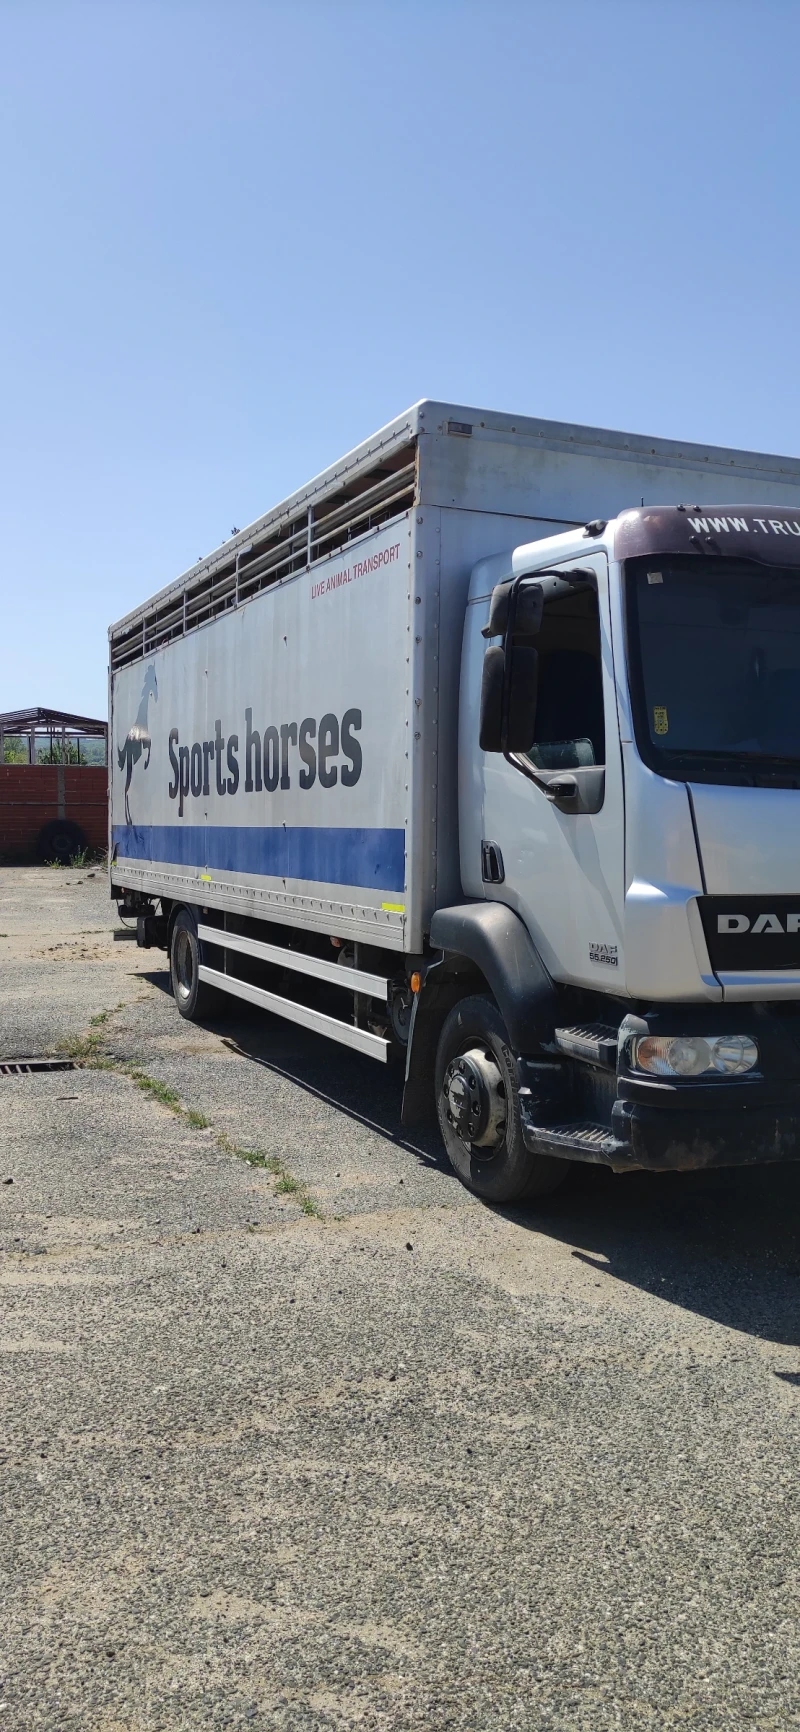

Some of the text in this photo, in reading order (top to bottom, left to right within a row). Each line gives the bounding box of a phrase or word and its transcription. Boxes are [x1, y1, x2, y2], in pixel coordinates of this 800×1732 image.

[311, 543, 401, 599] LIVE ANIMAL TRANSPORT
[168, 708, 363, 817] Sports horses
